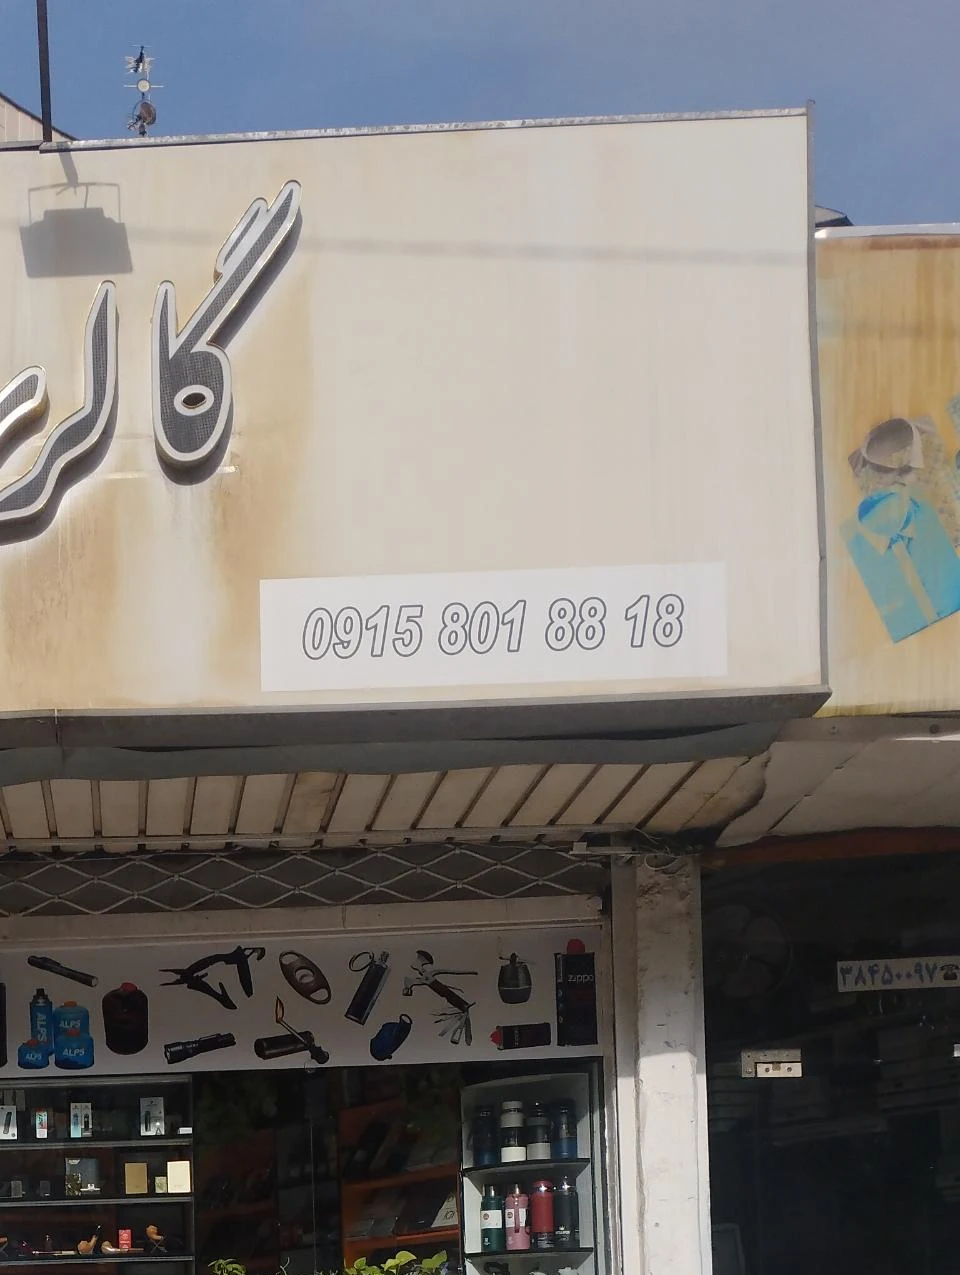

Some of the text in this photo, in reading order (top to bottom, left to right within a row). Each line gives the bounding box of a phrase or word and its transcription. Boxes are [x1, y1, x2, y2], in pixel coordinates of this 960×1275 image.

[302, 593, 685, 661] 0915 801 88 18
[58, 1019, 81, 1029] ALPS
[62, 1048, 85, 1057] ALPS
